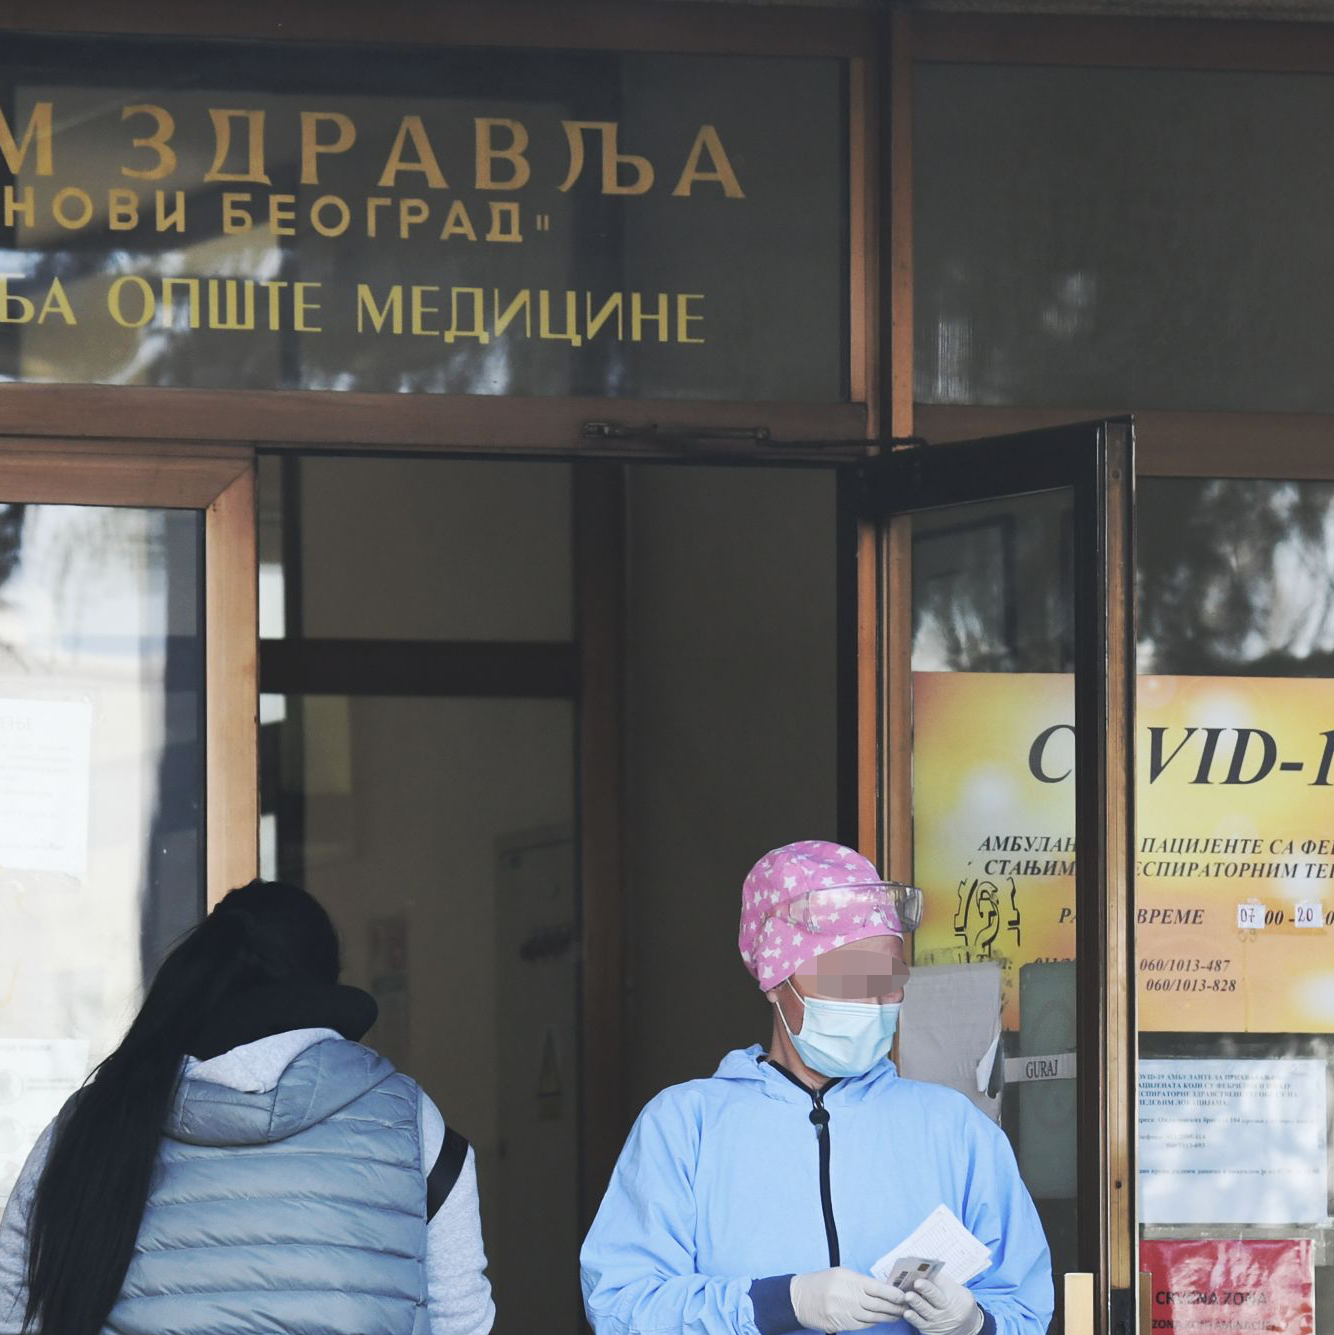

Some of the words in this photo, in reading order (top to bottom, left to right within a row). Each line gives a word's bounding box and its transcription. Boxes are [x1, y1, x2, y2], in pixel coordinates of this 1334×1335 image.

[119, 102, 746, 199] ЗДРАВЉА
[108, 274, 323, 334] ОПШТЕ
[357, 282, 706, 347] МЕДИЦИНЕ
[978, 835, 1076, 852] АМБУЛАН
[1141, 837, 1264, 857] ПАЦИЈЕНТЕ
[1269, 838, 1298, 856] СА
[984, 859, 1076, 875] СТАЊИМ
[1137, 861, 1298, 879] СПИРАТОРНИМ
[1136, 908, 1205, 926] ВРЕМЕ
[1139, 958, 1231, 974] 060/1013-487
[1145, 978, 1237, 993] 060/1013-828
[1025, 1059, 1059, 1079] GURAJ
